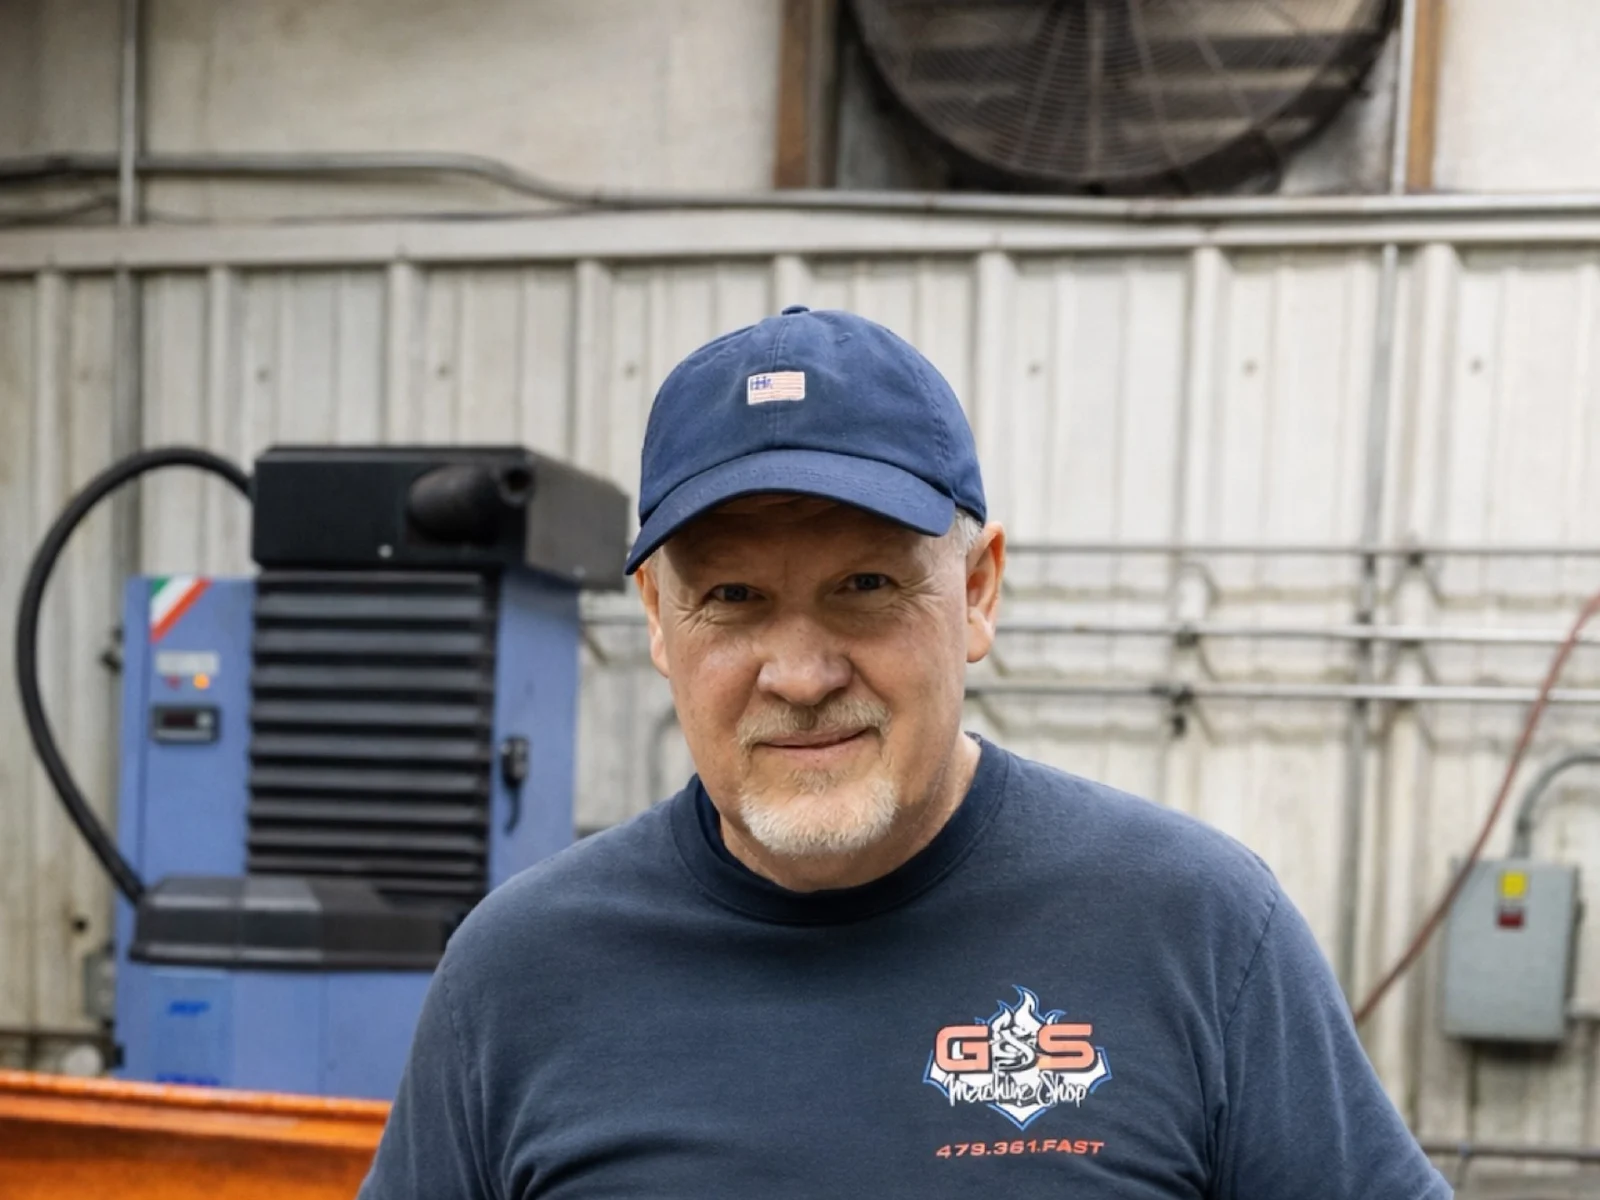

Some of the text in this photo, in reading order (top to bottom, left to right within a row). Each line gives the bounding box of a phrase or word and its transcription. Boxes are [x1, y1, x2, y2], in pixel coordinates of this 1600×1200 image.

[943, 1068, 1087, 1108] Machine Shop
[935, 1139, 1105, 1159] 479.361.FAST
